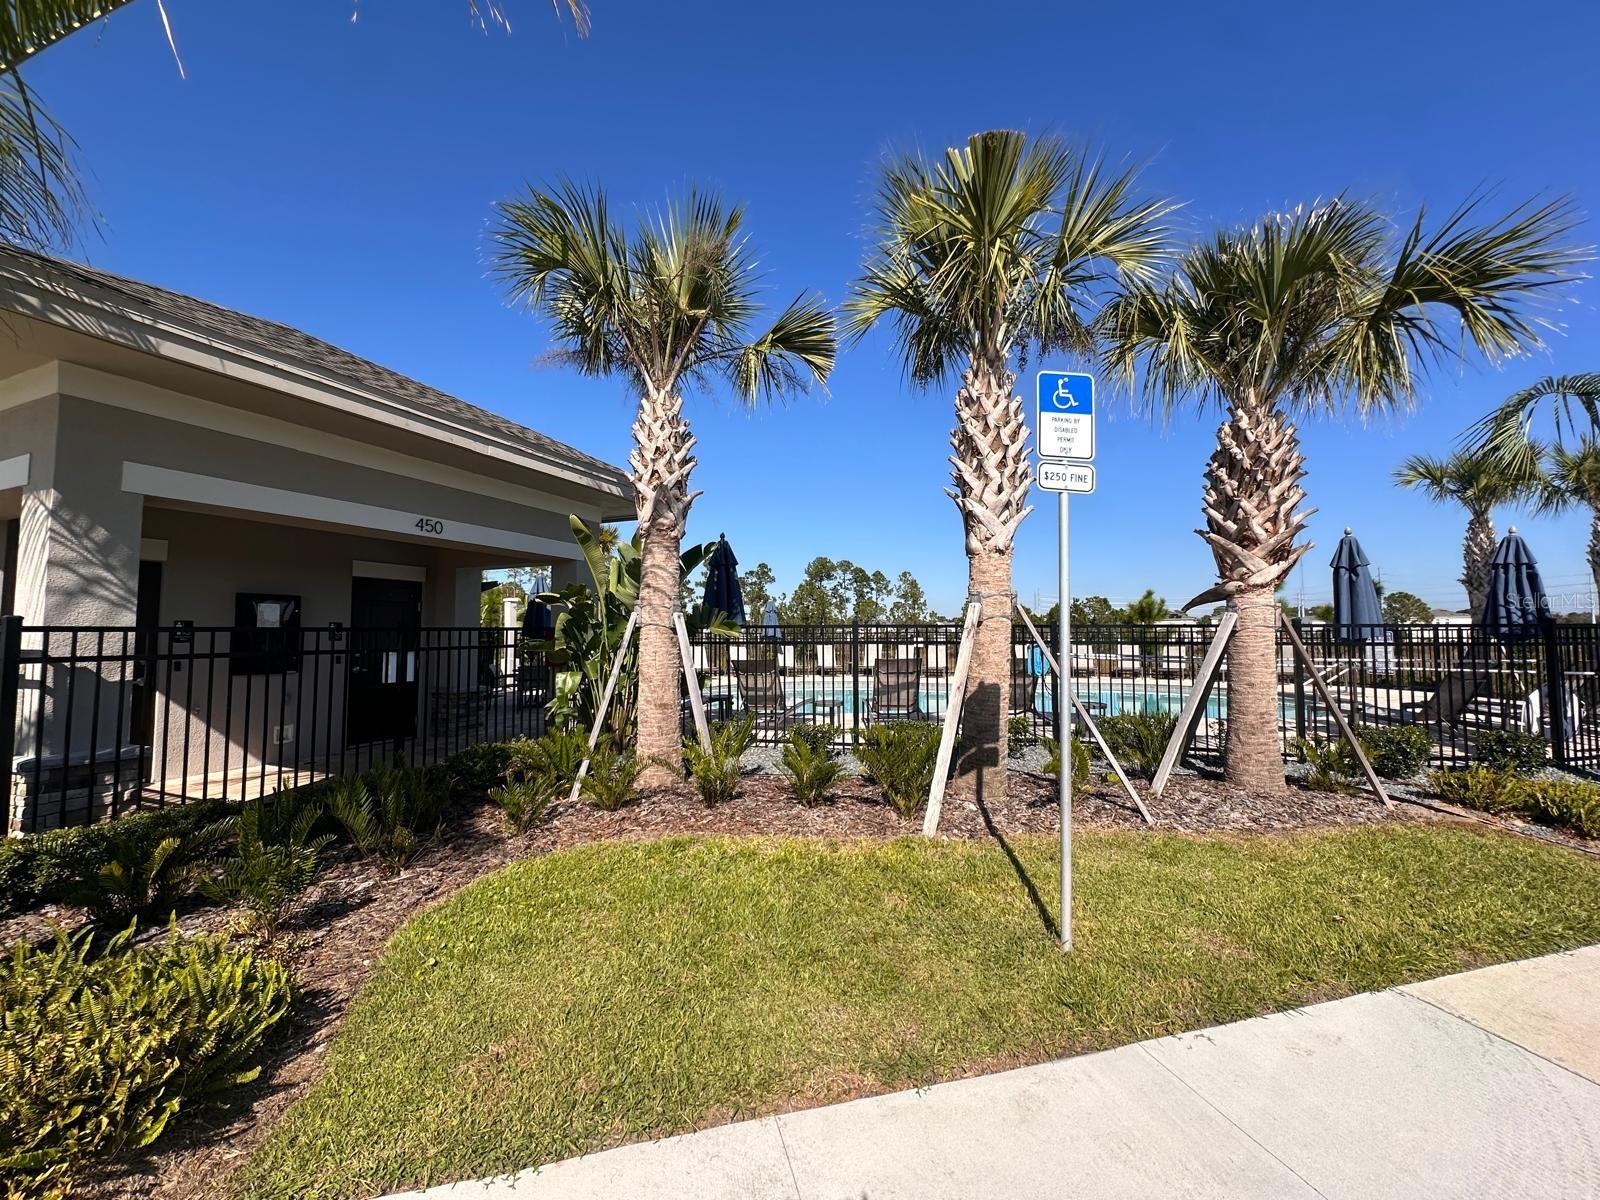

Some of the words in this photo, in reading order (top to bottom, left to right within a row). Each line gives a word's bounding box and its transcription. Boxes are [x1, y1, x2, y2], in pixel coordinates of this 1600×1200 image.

[1044, 472, 1067, 482] $250
[1070, 474, 1088, 483] FINE
[415, 518, 443, 535] 450
